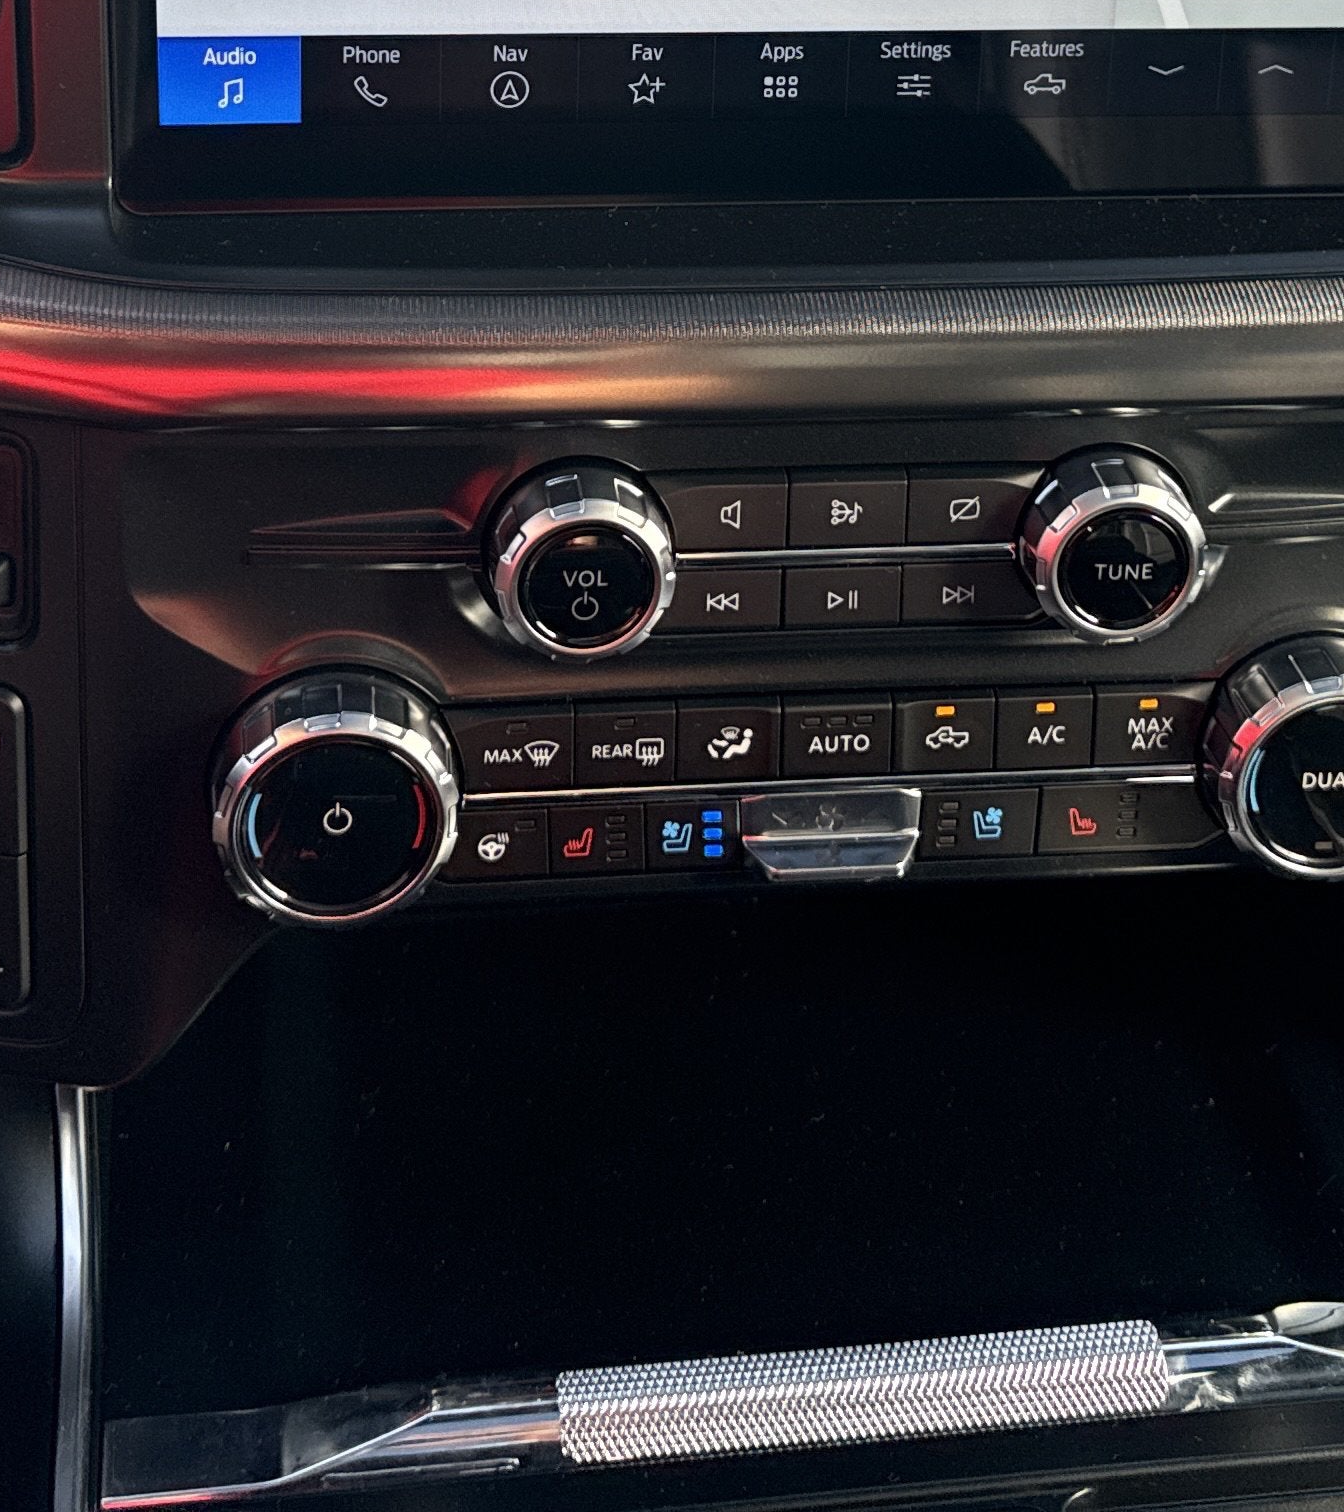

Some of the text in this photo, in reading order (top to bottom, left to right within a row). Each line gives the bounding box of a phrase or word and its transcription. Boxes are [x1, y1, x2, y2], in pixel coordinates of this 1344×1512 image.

[202, 45, 257, 66] Audio
[342, 44, 401, 64] Phone
[493, 44, 529, 63] Nav
[631, 43, 664, 62] Fav
[759, 42, 805, 65] Apps
[879, 40, 952, 64] Settings
[1009, 40, 1085, 59] Features
[562, 569, 609, 588] VOL
[1094, 563, 1154, 582] TUNE
[1028, 725, 1066, 745] A/C
[1128, 716, 1174, 737] MAX
[808, 733, 871, 753] AUTO
[1130, 731, 1169, 751] A/C
[483, 747, 523, 765] MAX
[591, 743, 634, 760] REAR
